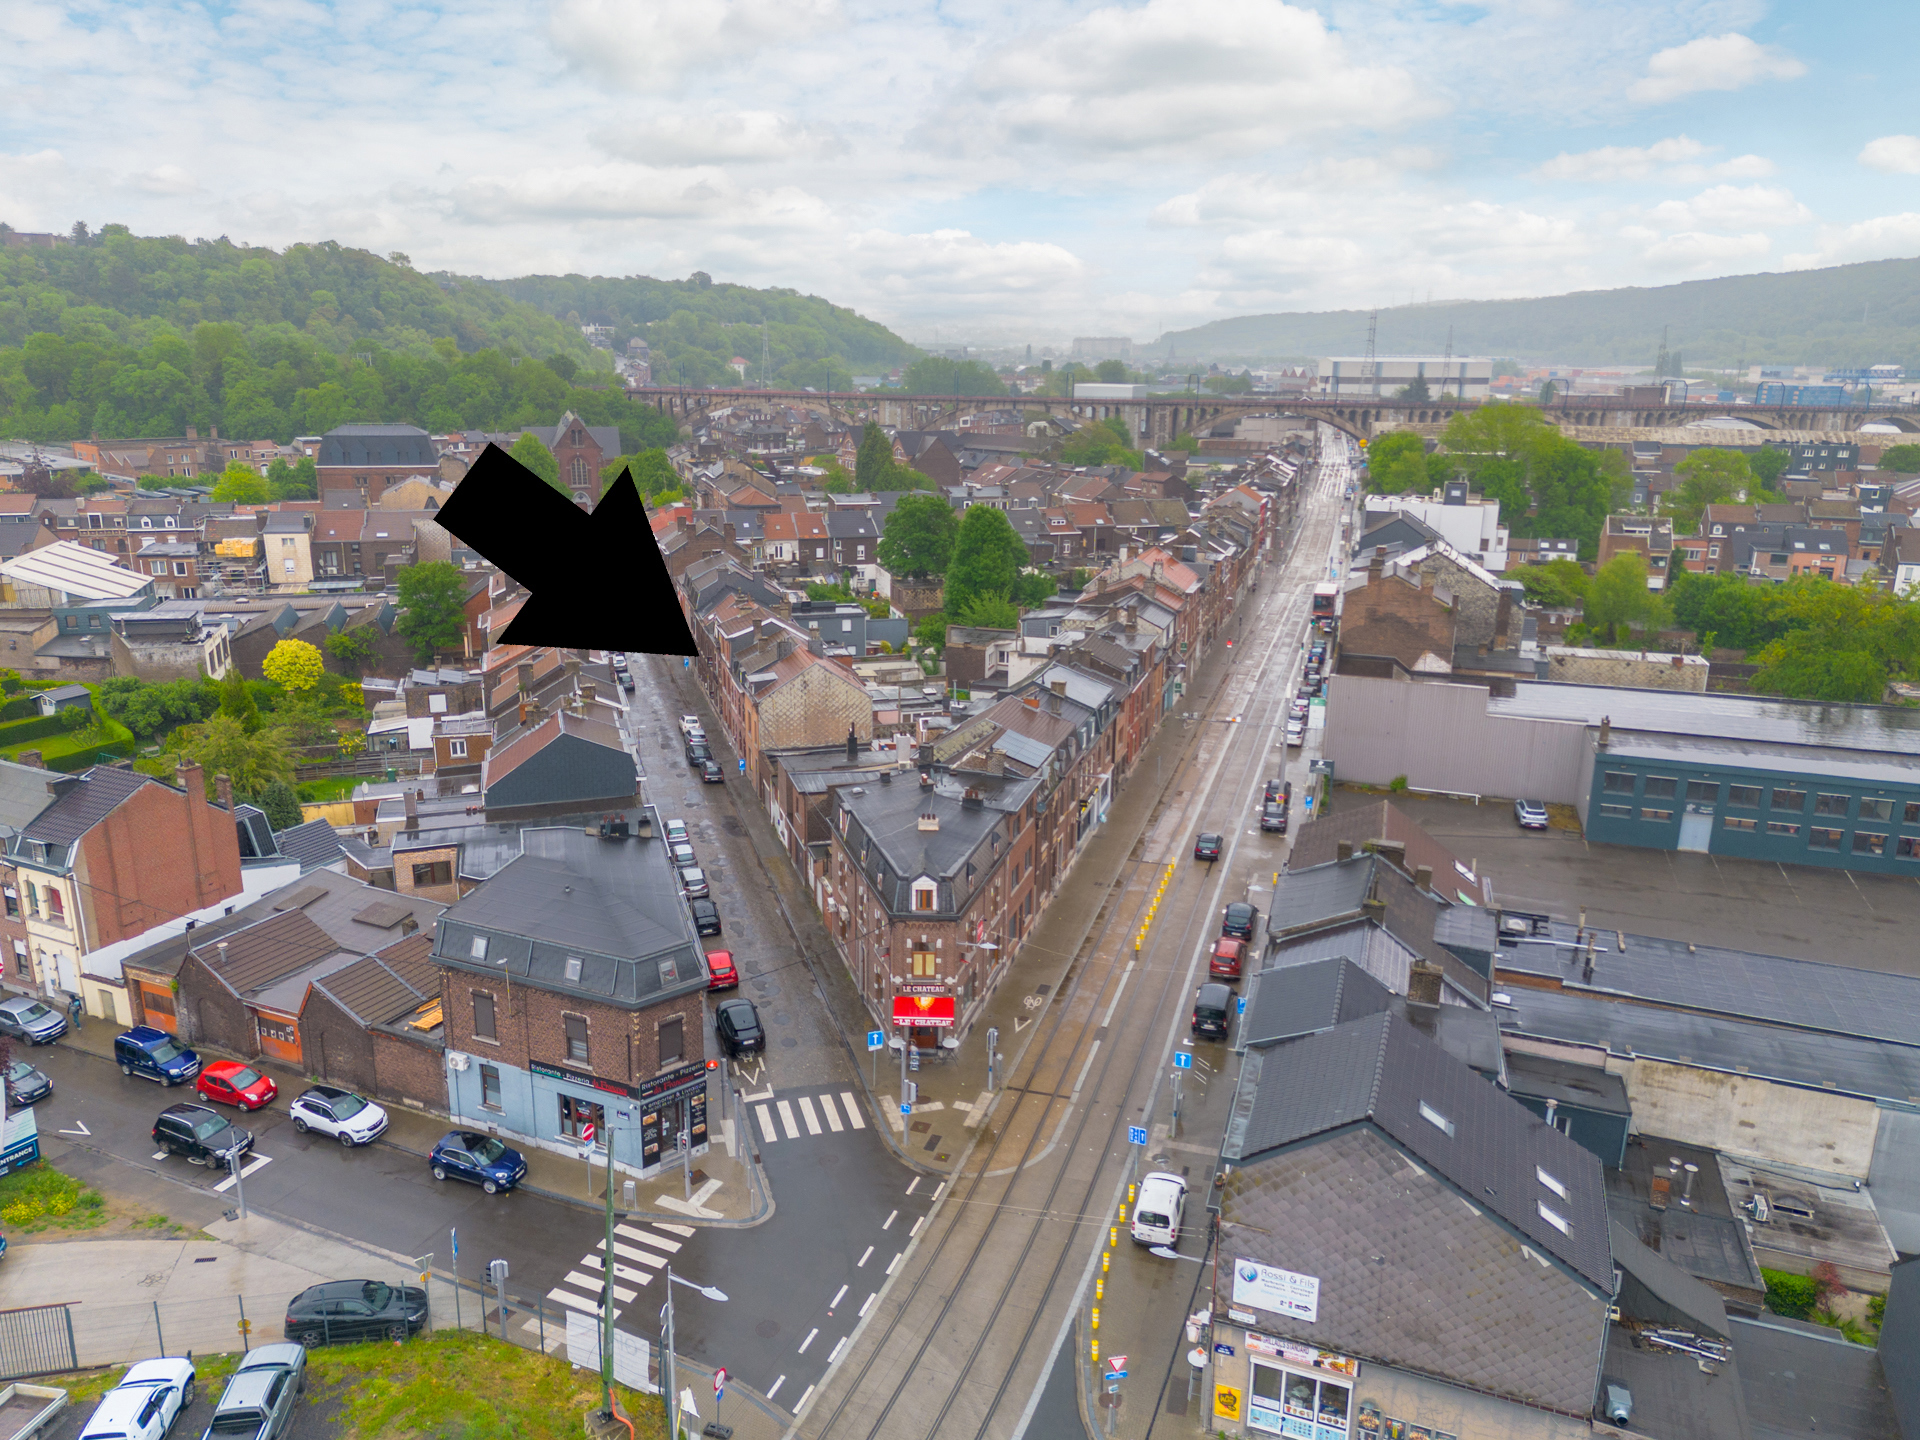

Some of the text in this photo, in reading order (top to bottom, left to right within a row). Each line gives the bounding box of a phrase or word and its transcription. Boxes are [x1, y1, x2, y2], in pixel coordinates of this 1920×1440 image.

[531, 1063, 561, 1077] Ristorante
[566, 1072, 590, 1084] Pizzeria
[641, 1074, 675, 1091] Ristorante
[679, 1061, 705, 1076] Pizzeria
[0, 1146, 34, 1166] NTRANCE
[1261, 1268, 1316, 1289] Rossi & Fils
